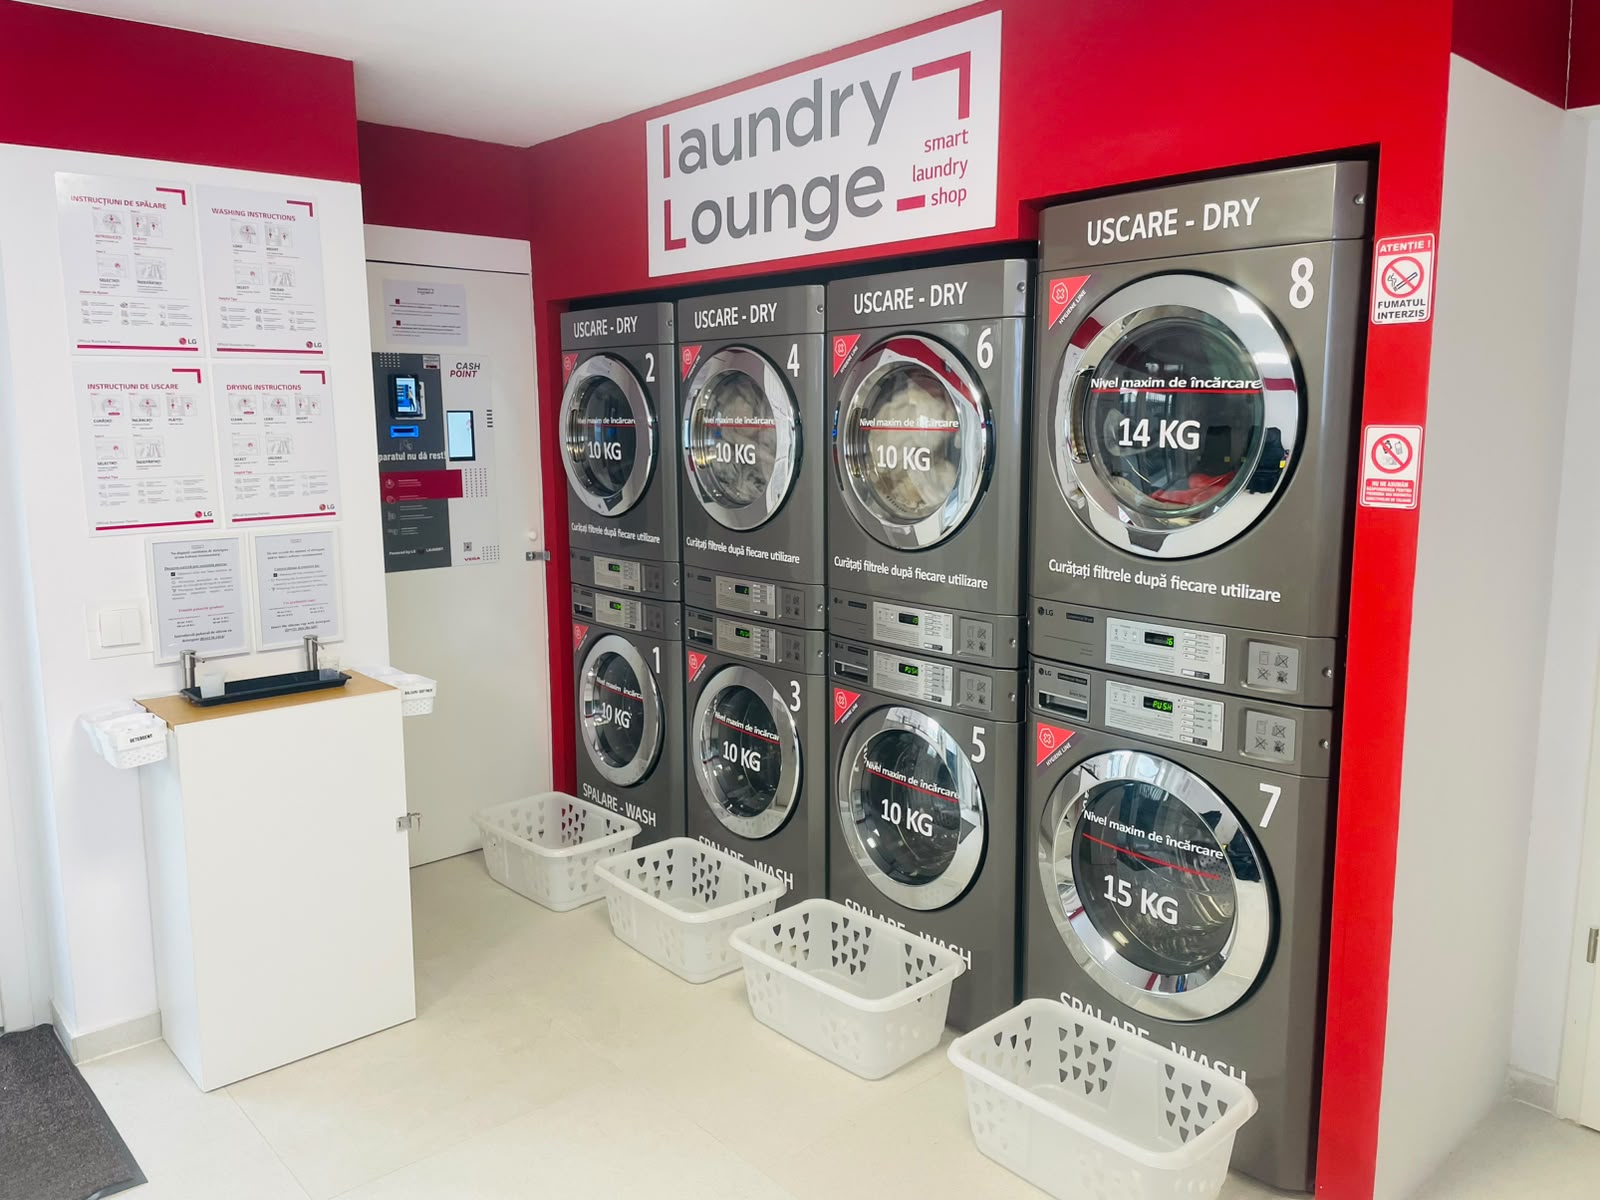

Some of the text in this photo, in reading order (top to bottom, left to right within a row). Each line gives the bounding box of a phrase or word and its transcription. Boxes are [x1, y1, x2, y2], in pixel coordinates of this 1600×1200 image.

[662, 71, 901, 178] laundry
[924, 129, 968, 153] smart
[912, 158, 968, 183] laundry
[663, 165, 885, 251] Lounge
[930, 186, 967, 207] shop
[212, 208, 296, 222] WASHING INSTRUCTIONS
[1087, 209, 1178, 246] USCARE
[1203, 197, 1261, 231] DRY
[1289, 257, 1314, 309] 8
[854, 287, 914, 314] USCARE
[930, 282, 968, 307] DRY
[1058, 289, 1086, 325] HYGIENE LINE
[1378, 299, 1426, 309] FUMATUL
[573, 319, 608, 338] USCARE
[616, 316, 638, 334] DRY
[694, 306, 738, 329] USCARE
[750, 302, 778, 323] DRY
[1378, 310, 1425, 319] INTERZIS
[787, 343, 800, 377] 4
[977, 327, 993, 369] 6
[450, 370, 477, 378] POINT
[456, 362, 480, 370] CASH
[645, 352, 655, 382] 2
[1091, 377, 1263, 389] Nivel maxim de încărcare
[860, 418, 875, 427] Nivel
[876, 418, 901, 426] maxim
[904, 418, 914, 426] de
[1118, 418, 1200, 450] 14 KG
[588, 441, 622, 460] 10 KG
[716, 443, 756, 464] 10 KG
[877, 445, 930, 471] 10 KG
[604, 527, 616, 538] după
[617, 528, 636, 540] fiecare
[637, 532, 660, 544] utilizare
[708, 540, 727, 553] filtrele
[728, 544, 745, 557] după
[746, 546, 769, 559] fiecare
[770, 551, 800, 564] utilizare
[834, 556, 988, 589] Curățați filtrele după fiecare utilizare
[1048, 558, 1281, 603] Curățați filtrele după fiecare utilizare
[652, 647, 660, 674] 1
[790, 680, 801, 712] 3
[1152, 700, 1172, 711] PUSH
[602, 702, 630, 729] 10 KG
[745, 722, 753, 732] de
[723, 741, 761, 772] 10 KG
[971, 726, 986, 763] 5
[1061, 742, 1072, 753] LINE
[866, 760, 882, 773] Nivel
[882, 768, 906, 782] maxim
[908, 776, 918, 786] de
[582, 782, 618, 812] SPALARE
[625, 802, 656, 827] WASH
[881, 799, 933, 837] 10 KG
[1259, 783, 1281, 829] 7
[1084, 810, 1223, 860] Nivel maxim de încărcare
[1104, 875, 1178, 925] 15 KG
